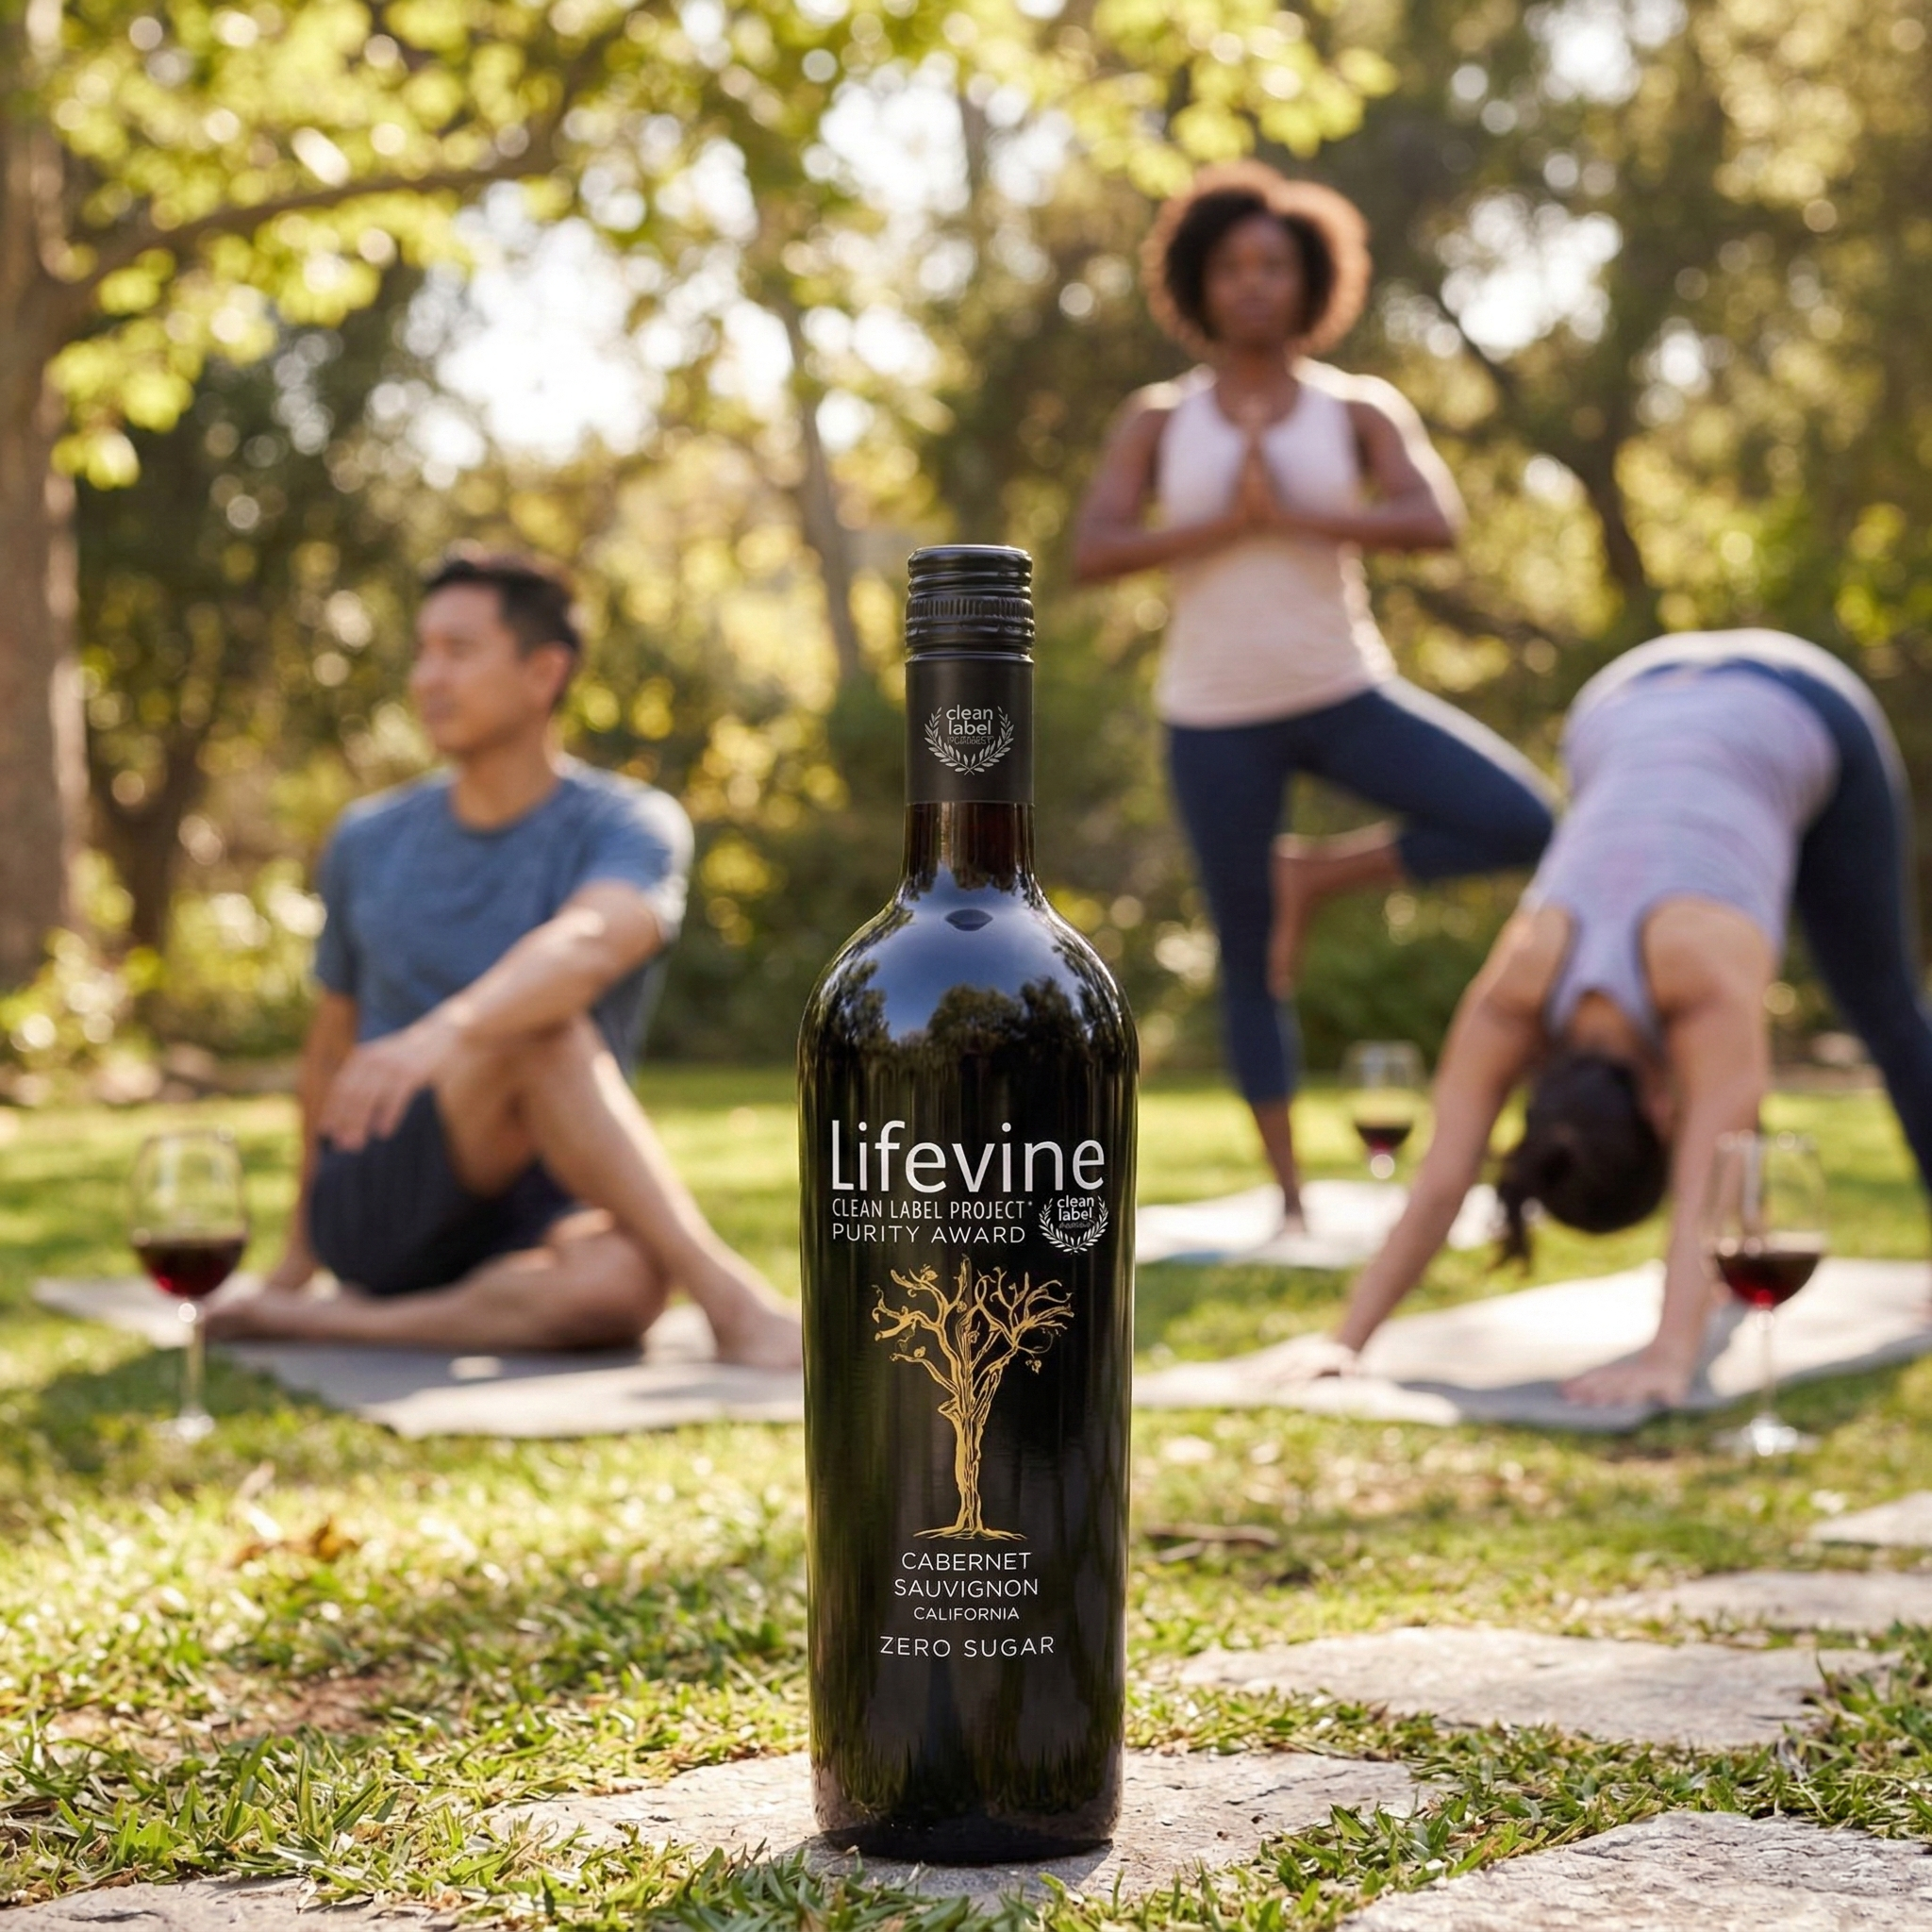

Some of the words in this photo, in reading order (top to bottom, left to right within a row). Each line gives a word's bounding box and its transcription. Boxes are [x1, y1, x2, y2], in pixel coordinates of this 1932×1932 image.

[945, 704, 993, 720] clean
[948, 720, 991, 735] label
[831, 1120, 1105, 1193] Lifevine
[832, 1198, 882, 1218] CLEAN
[890, 1200, 942, 1220] LABEL
[1057, 1194, 1094, 1208] clean
[1058, 1207, 1092, 1222] label
[832, 1223, 920, 1243] PURITY
[930, 1225, 1025, 1244] AWARD
[901, 1552, 1032, 1572] CABERNET
[894, 1578, 1039, 1598] SAUVIGNON
[913, 1607, 1020, 1622] CALIFORNIA
[879, 1636, 951, 1657] ZERO
[963, 1636, 1055, 1657] SUGAR
